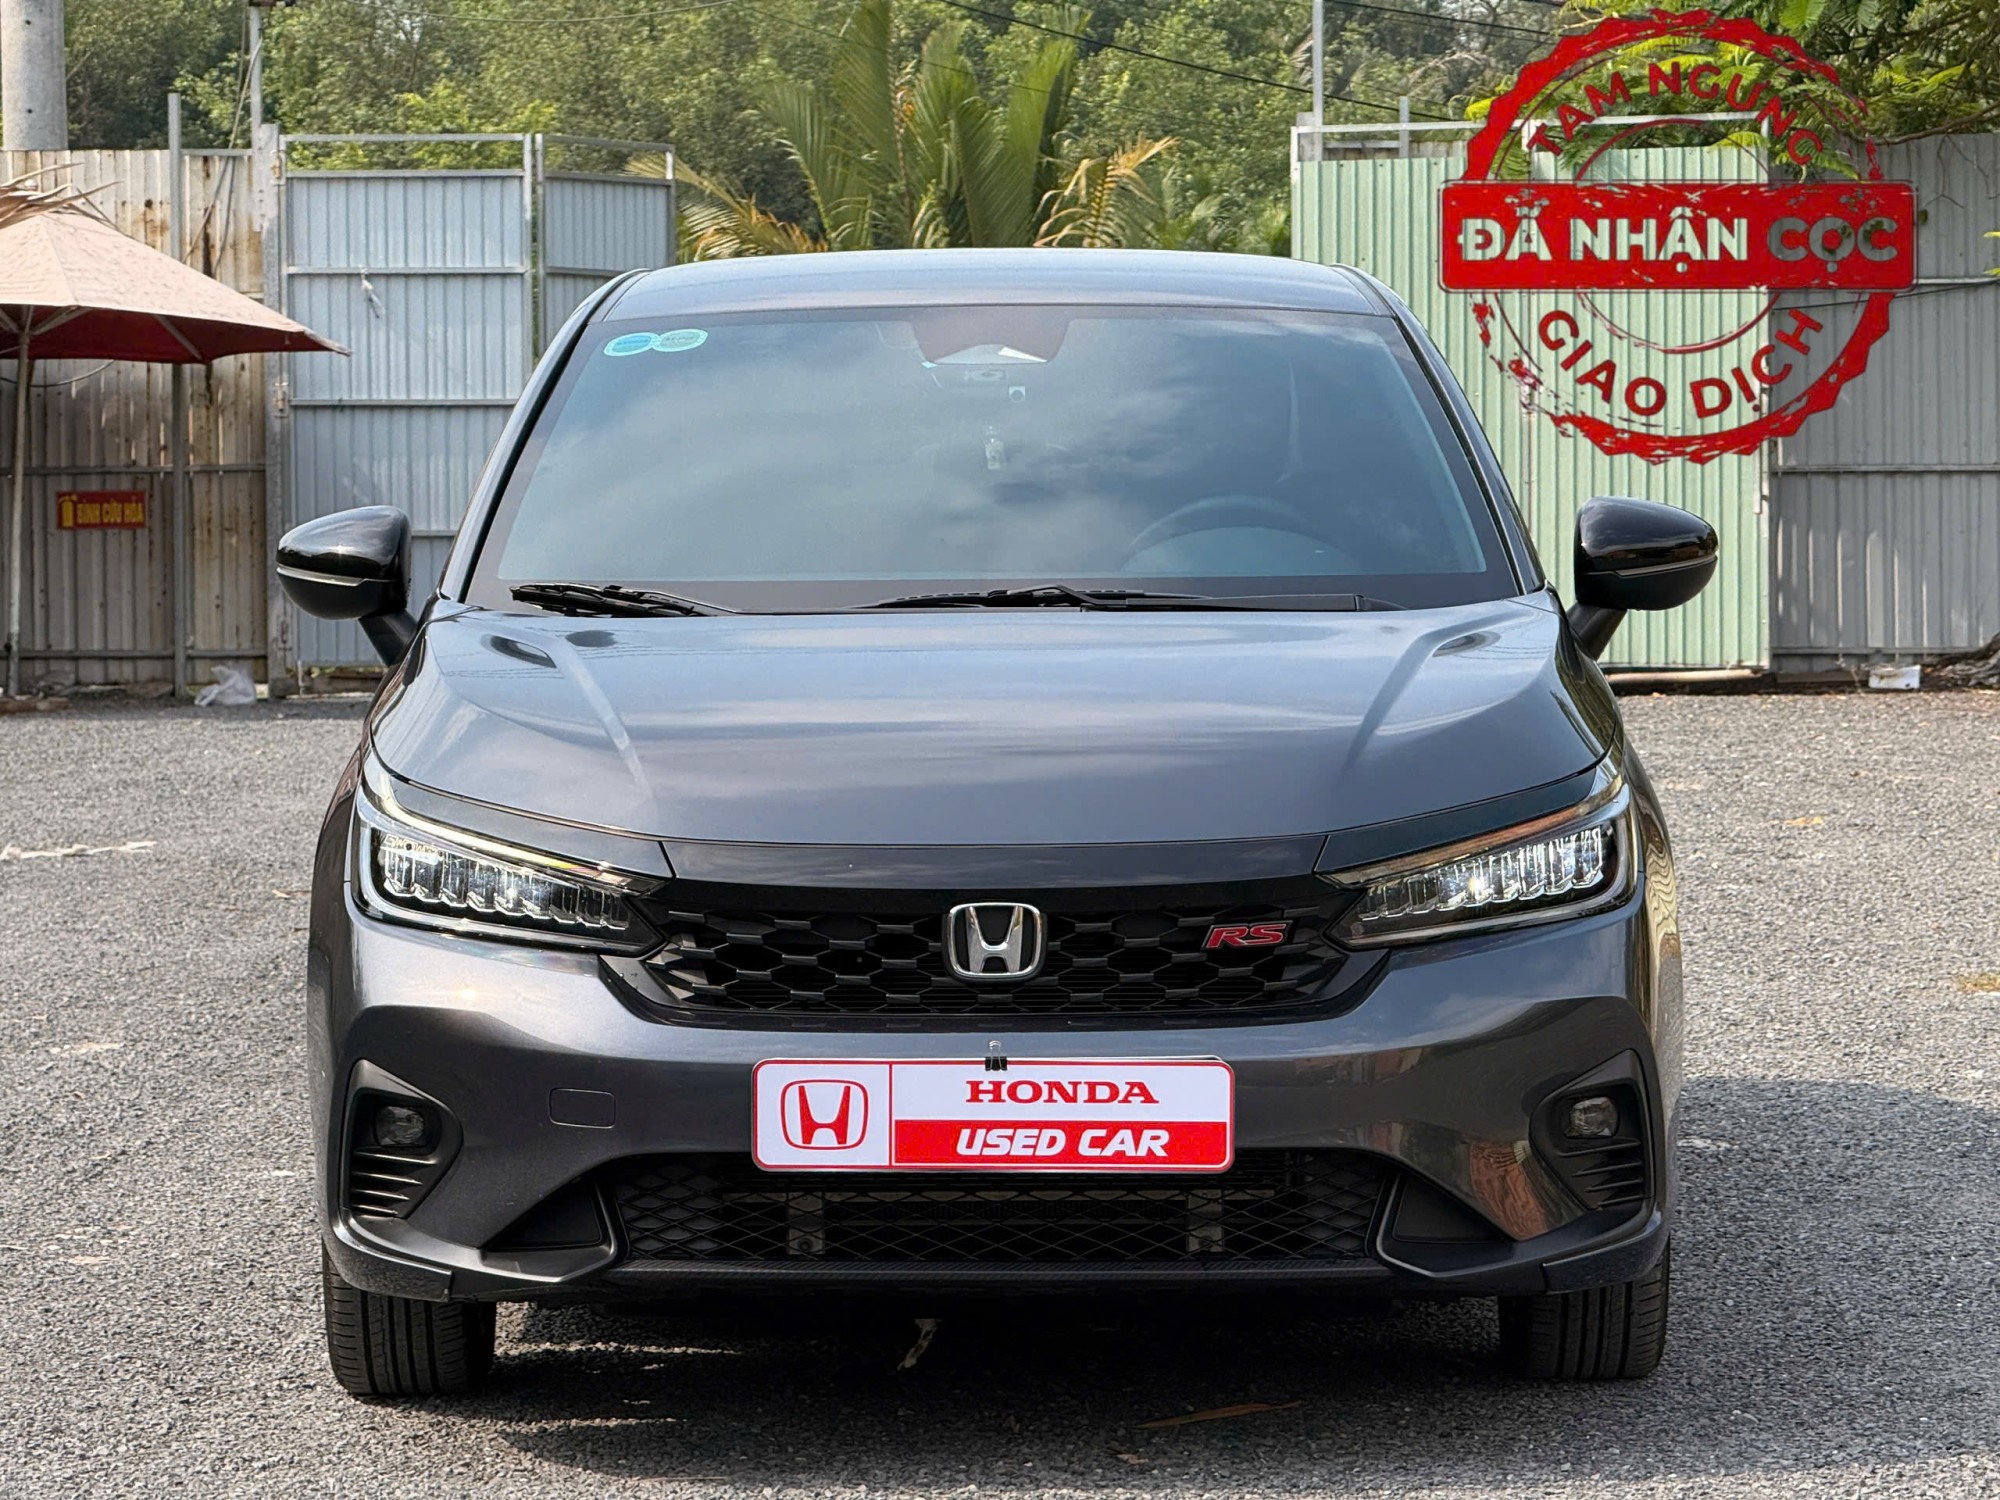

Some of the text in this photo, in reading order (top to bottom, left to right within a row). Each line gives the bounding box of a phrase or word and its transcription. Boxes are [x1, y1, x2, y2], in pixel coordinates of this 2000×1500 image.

[1206, 923, 1287, 949] RS
[965, 1080, 1160, 1105] HONDA
[956, 1128, 1170, 1157] USED CAR
